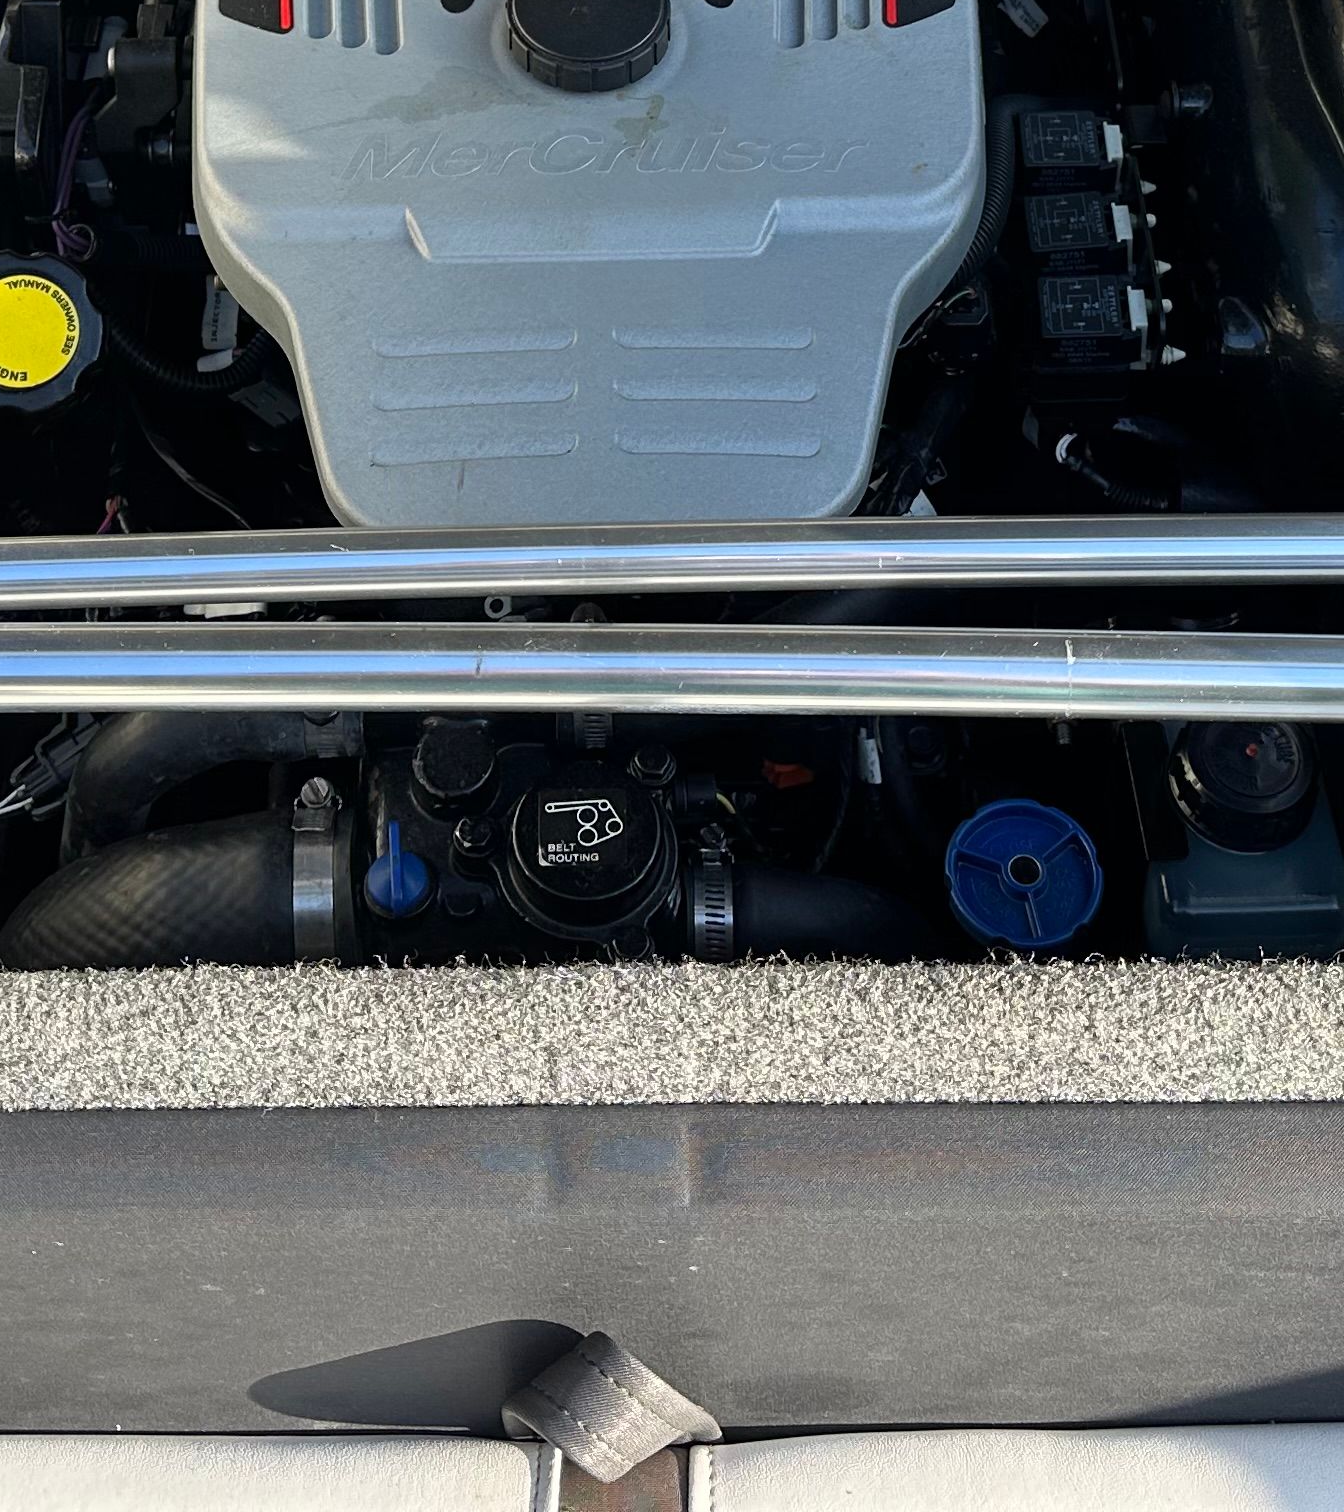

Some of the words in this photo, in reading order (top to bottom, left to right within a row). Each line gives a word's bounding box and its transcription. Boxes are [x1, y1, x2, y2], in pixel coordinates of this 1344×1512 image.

[338, 127, 869, 182] MerCruiser
[4, 279, 50, 294] MANUAL
[50, 290, 76, 333] OWNERS
[211, 292, 221, 342] INJECTOR
[61, 335, 75, 356] SEE
[548, 843, 576, 852] BELT
[548, 853, 599, 863] ROUTING
